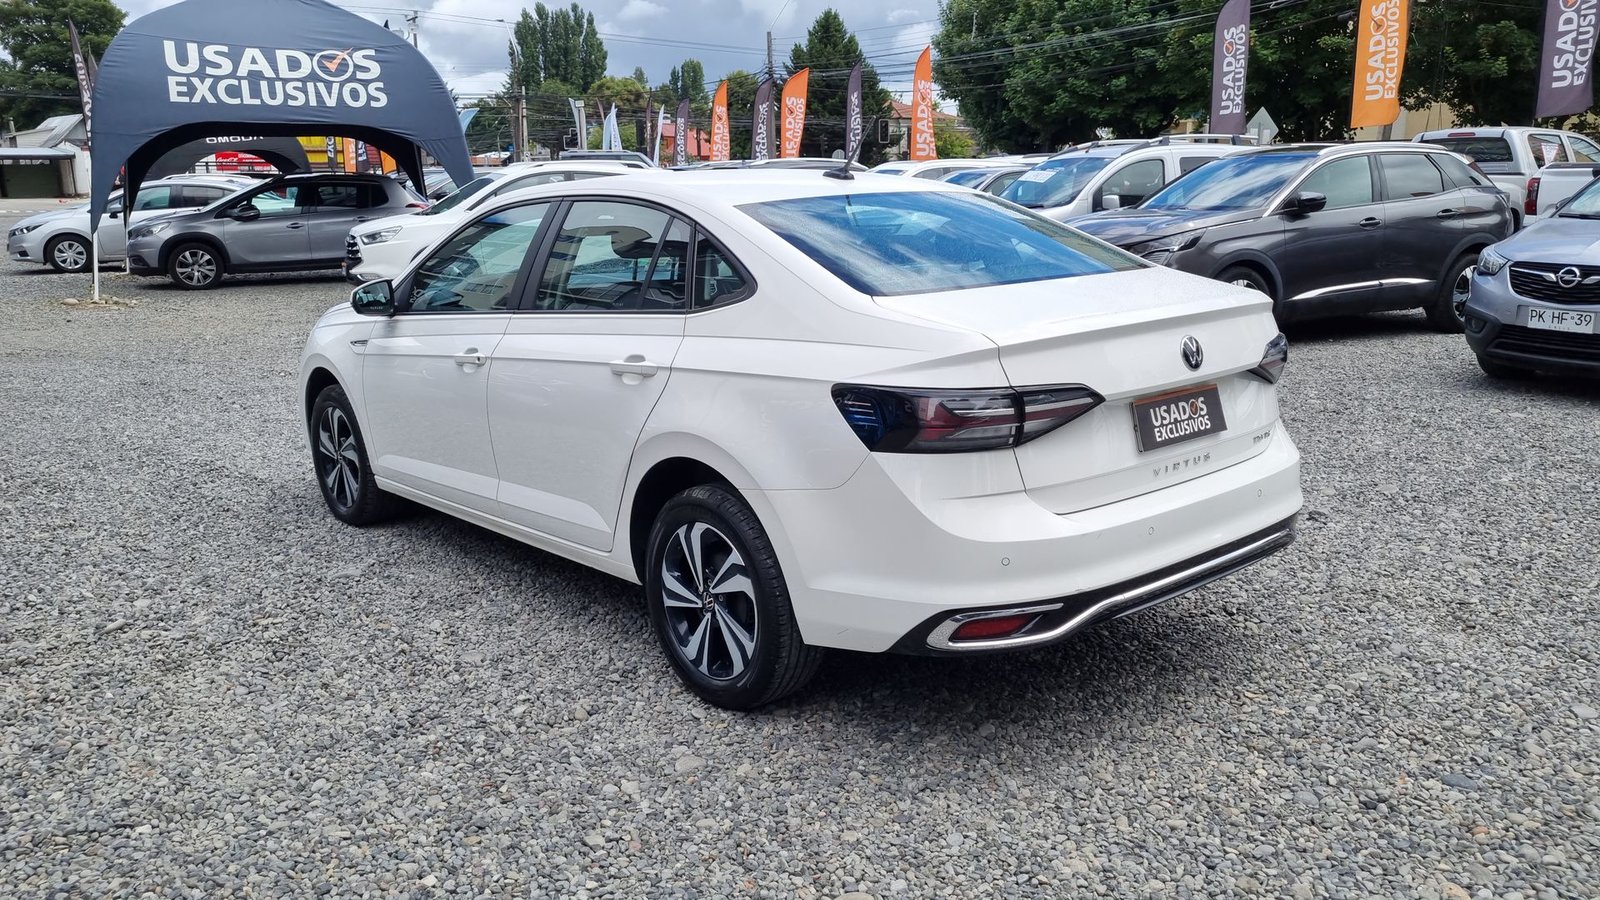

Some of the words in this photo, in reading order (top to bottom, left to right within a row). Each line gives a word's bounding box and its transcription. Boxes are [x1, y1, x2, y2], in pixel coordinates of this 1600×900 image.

[163, 39, 381, 82] USADOS
[1219, 26, 1237, 115] USADOS
[1232, 23, 1246, 114] EXCLUSIVOS
[1365, 2, 1387, 101] USADOS
[1384, 0, 1400, 99] EXCLUSIVOS
[167, 75, 388, 108] EXCLUSIVOS
[916, 80, 929, 156] USADOS
[713, 105, 724, 160] USADOS
[1150, 396, 1208, 426] USADOS
[1154, 415, 1211, 442] EXCLUSIVOS
[1153, 452, 1211, 477] VIRTUS
